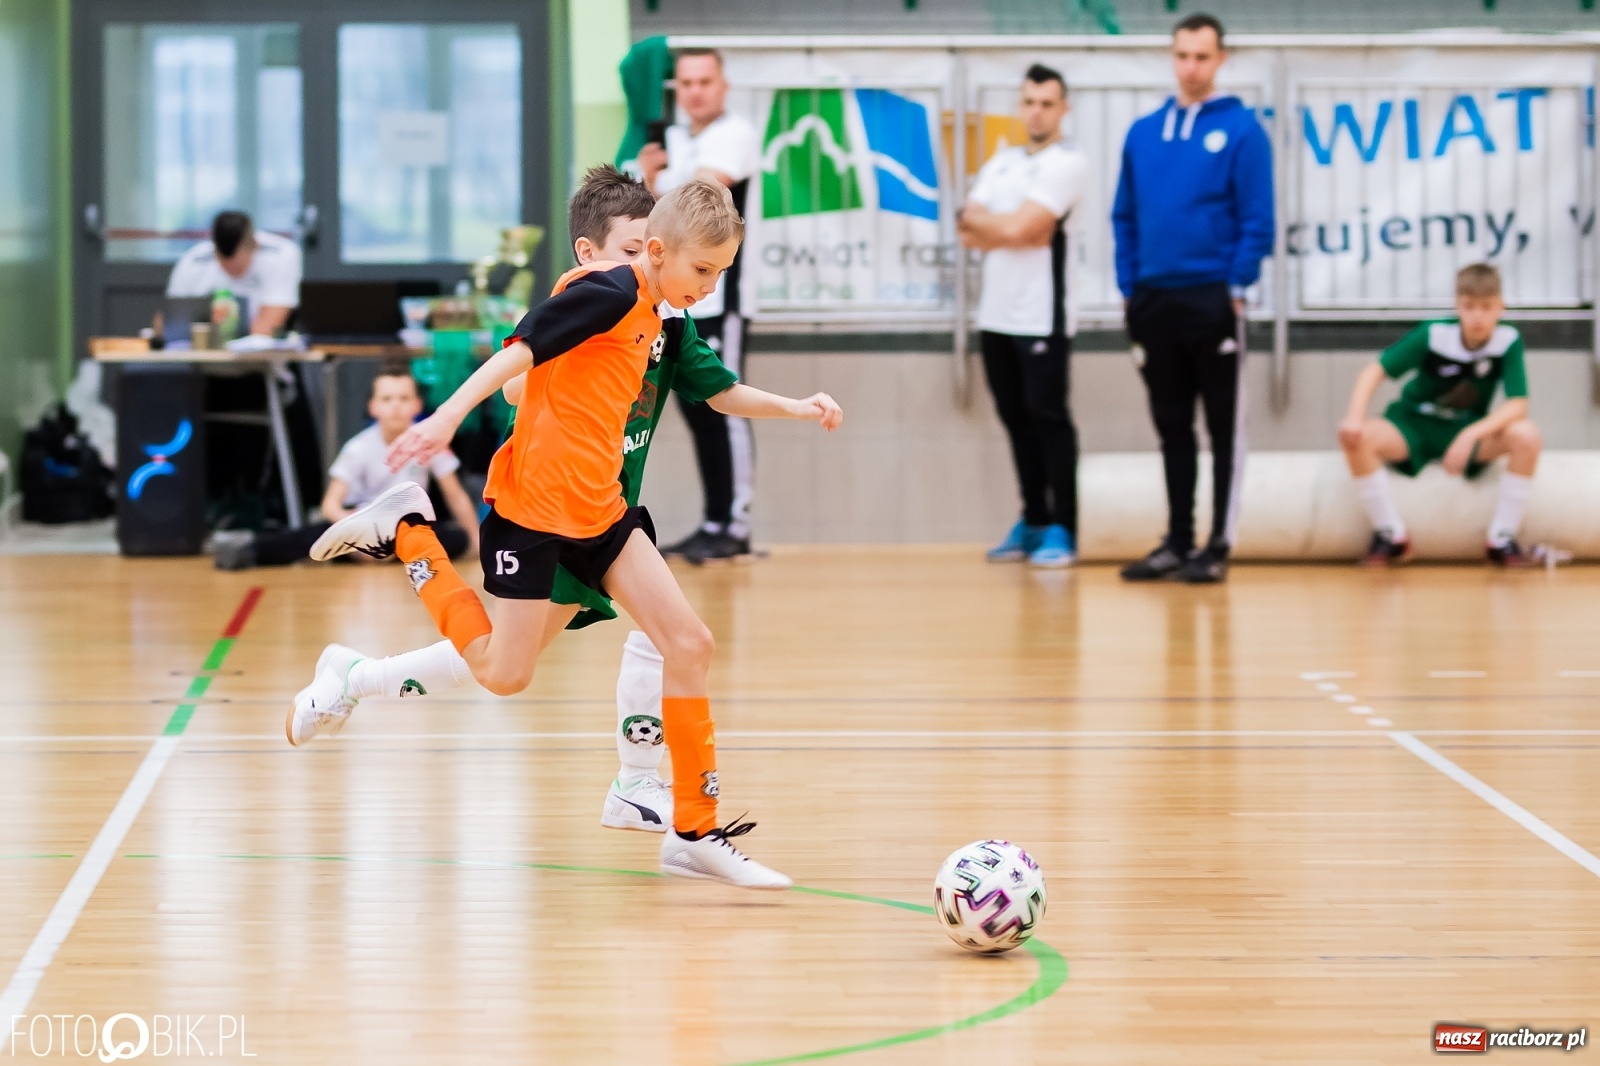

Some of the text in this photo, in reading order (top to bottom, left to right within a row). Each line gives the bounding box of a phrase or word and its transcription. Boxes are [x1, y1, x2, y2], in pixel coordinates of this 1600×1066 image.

[1263, 86, 1550, 165] WIAT
[1284, 206, 1530, 264] cujemy,
[495, 549, 520, 575] 15
